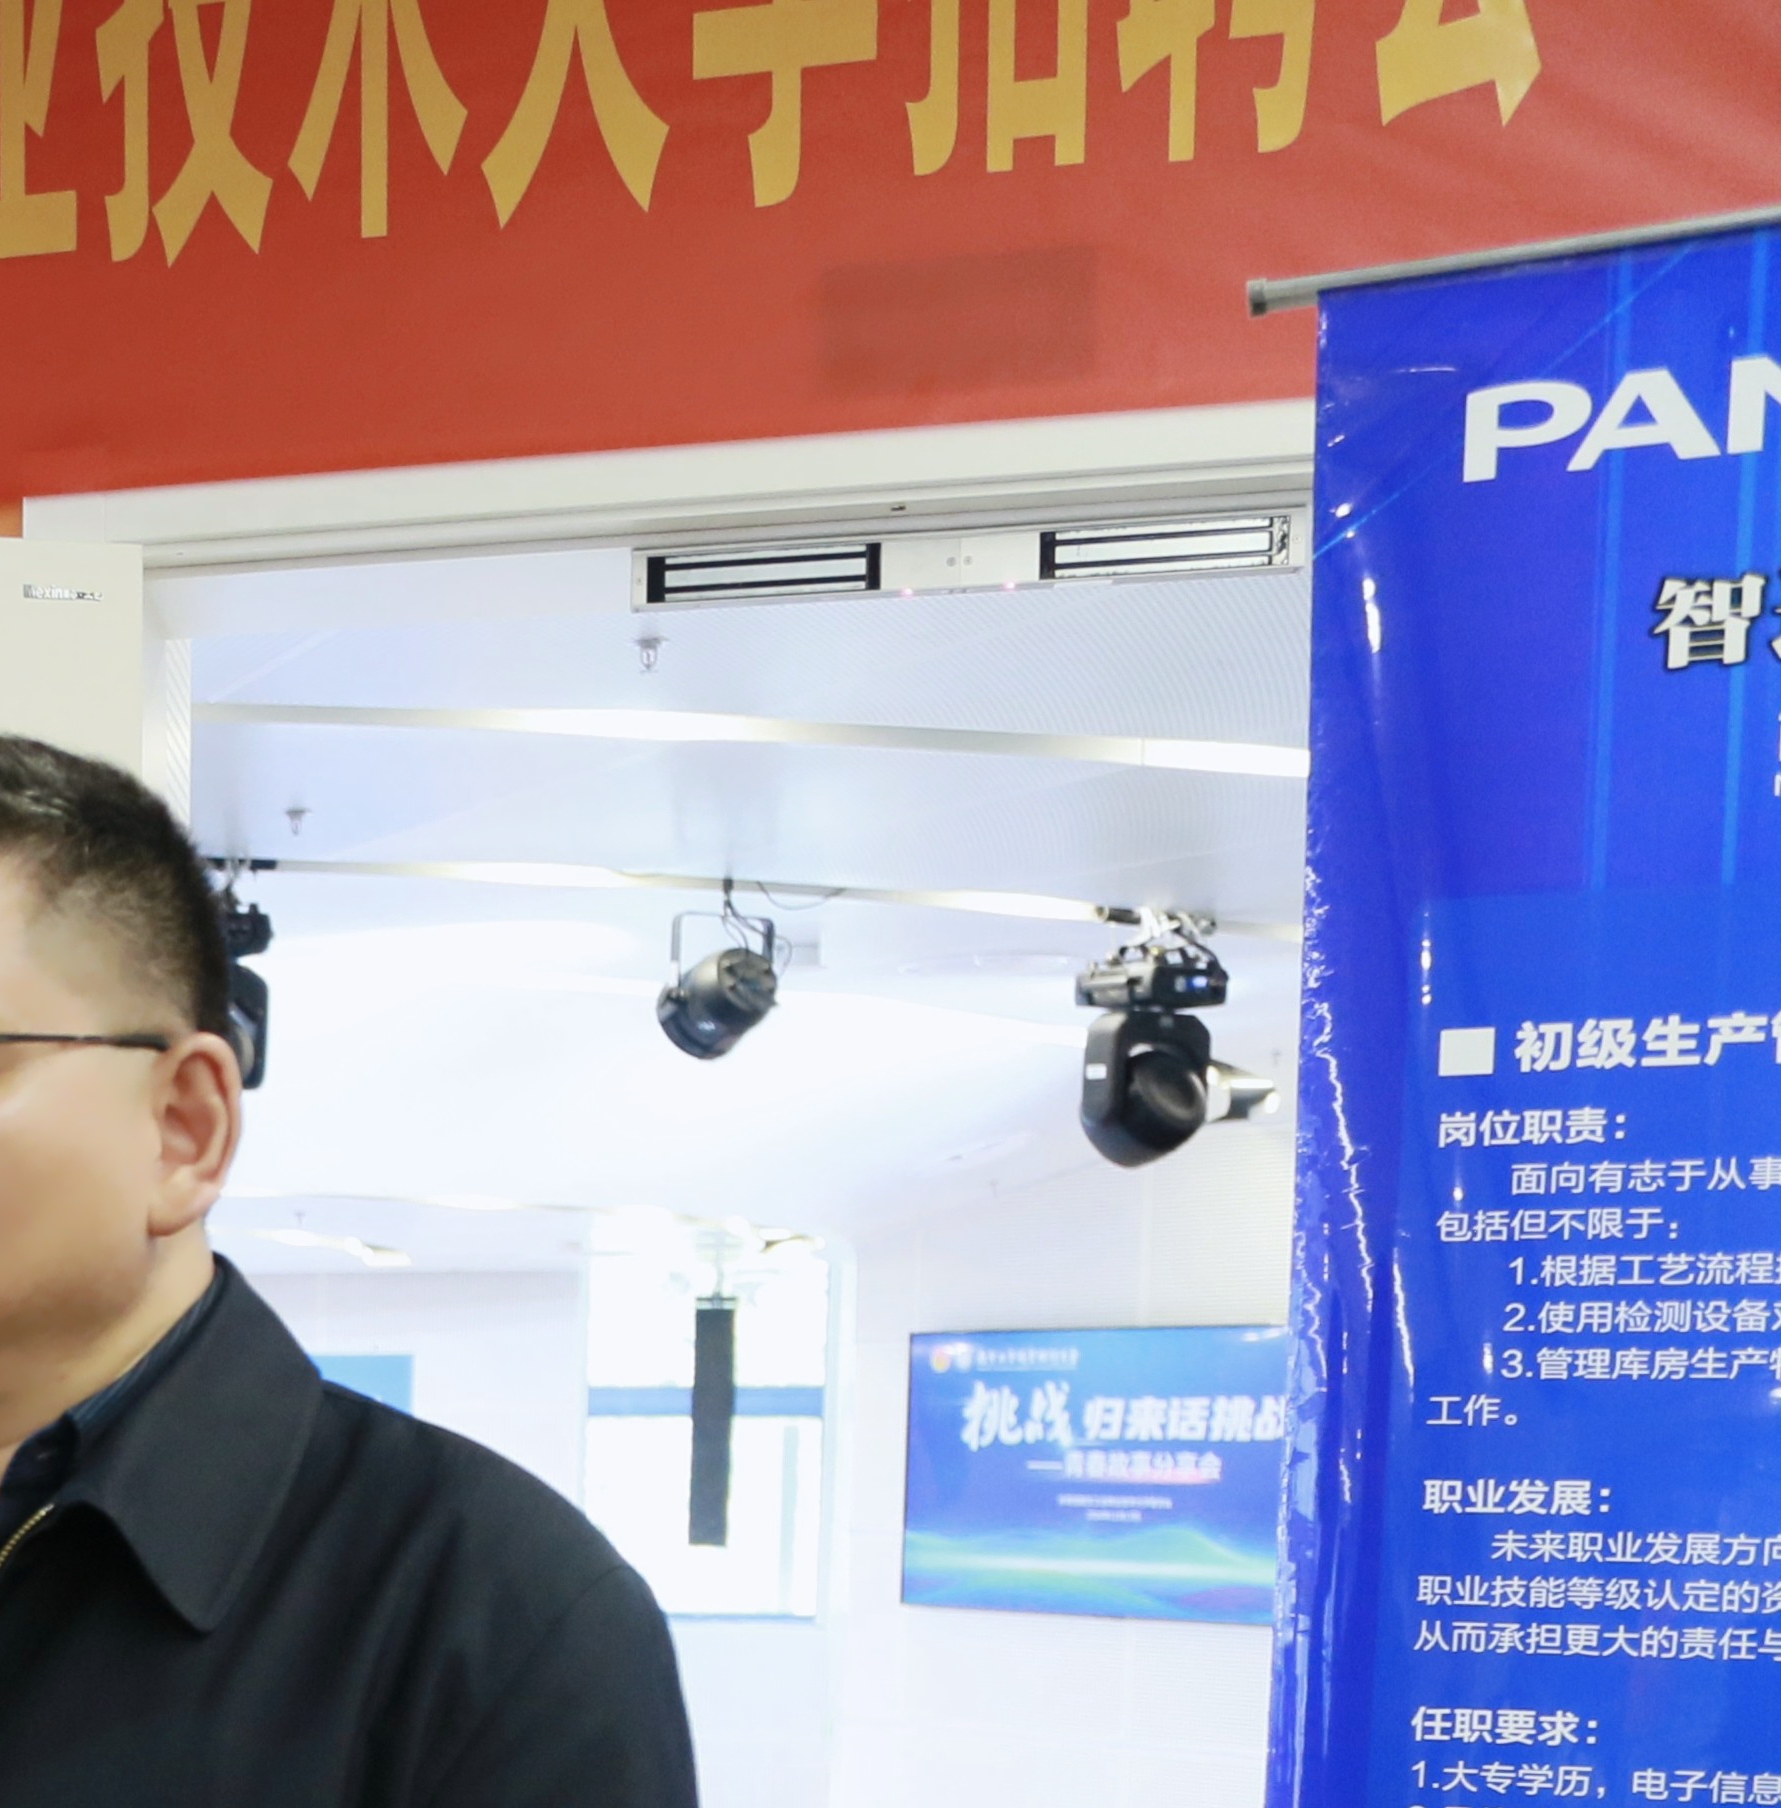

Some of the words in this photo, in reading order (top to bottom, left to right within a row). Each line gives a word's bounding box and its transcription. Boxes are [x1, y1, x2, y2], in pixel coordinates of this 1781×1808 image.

[1653, 572, 1781, 670] 智
[1515, 1011, 1781, 1074] 初级生产
[1438, 1107, 1627, 1148] 岗位职责：
[1511, 1155, 1781, 1195] 面向有志于从事
[1436, 1207, 1679, 1242] 包括但不限于：
[1509, 1253, 1781, 1287] 1.根据工艺流程
[1503, 1299, 1781, 1334] 2.使用检测设备
[1427, 1395, 1520, 1427] 工作。
[1422, 1478, 1611, 1515] 职业发展：
[1411, 1707, 1598, 1746] 任职要求：
[1411, 1761, 1781, 1805] 1.大专学历，电子信息
